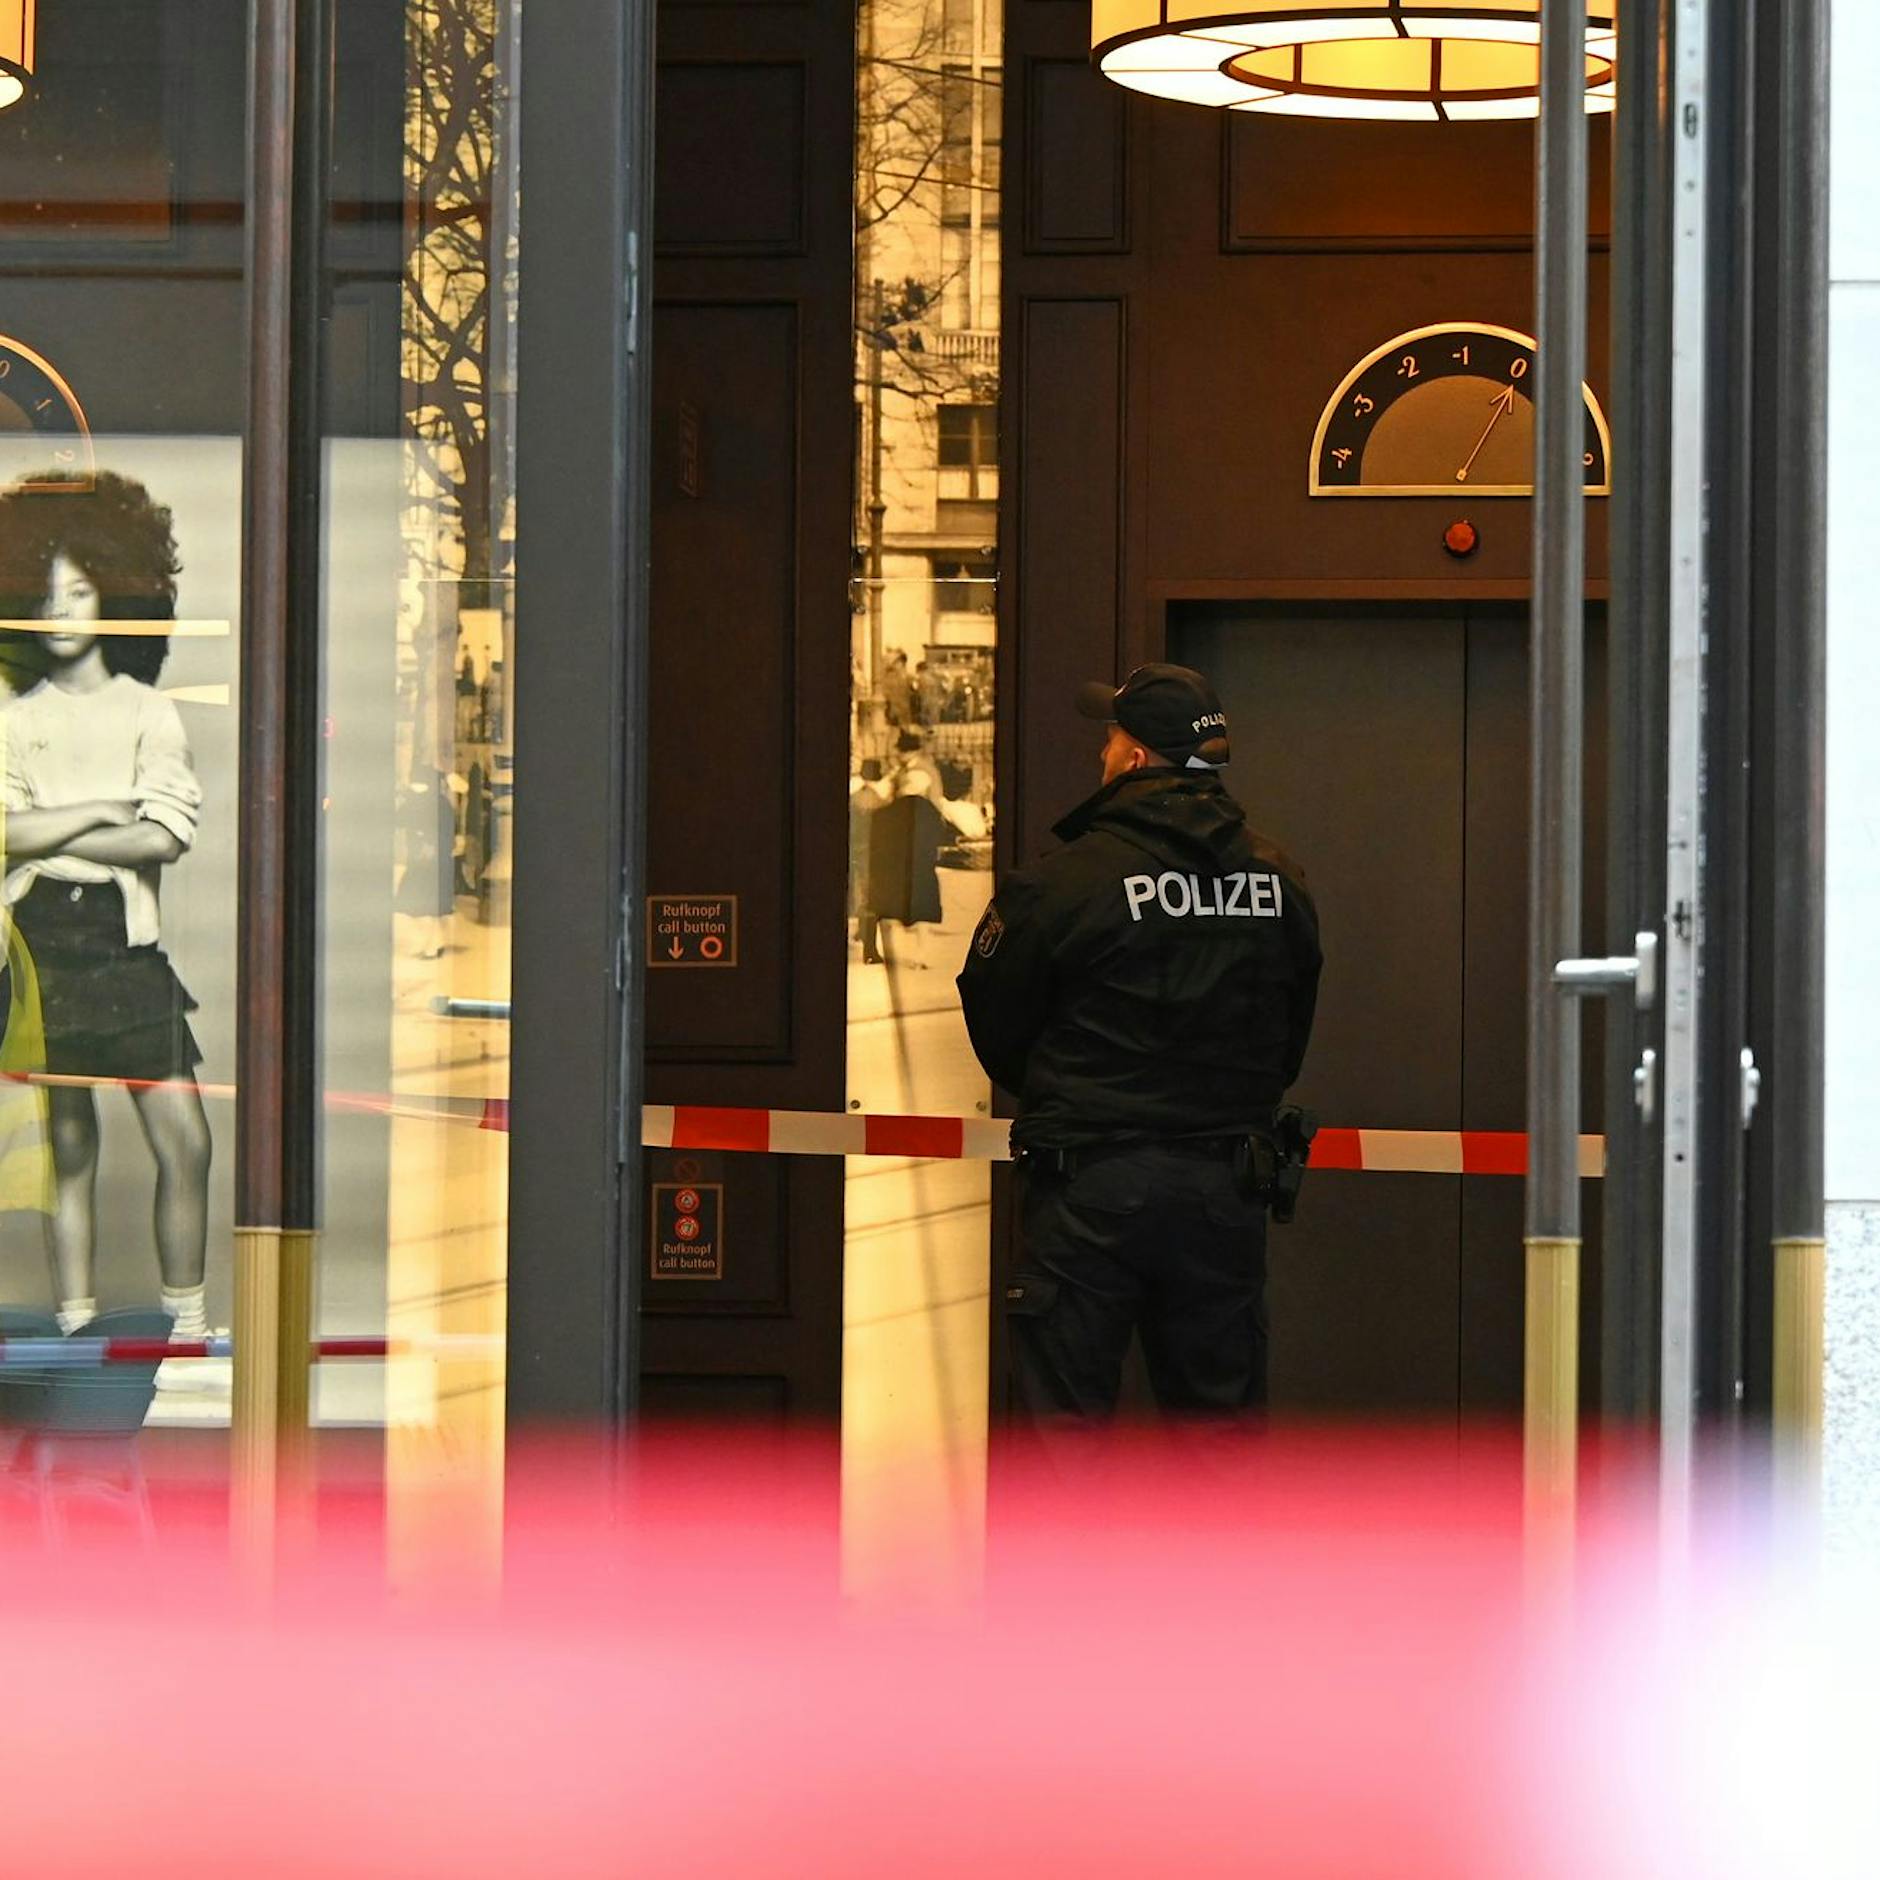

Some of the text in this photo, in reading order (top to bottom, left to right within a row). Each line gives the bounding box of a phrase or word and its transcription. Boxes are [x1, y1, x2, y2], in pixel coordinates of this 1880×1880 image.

[1331, 345, 1528, 469] -4 -3 -2 -1 0
[1123, 871, 1283, 922] POLIZEI
[663, 903, 721, 919] Rufknopf
[658, 920, 726, 934] call button
[663, 1243, 712, 1257] Rufknopf
[659, 1258, 716, 1269] call button
